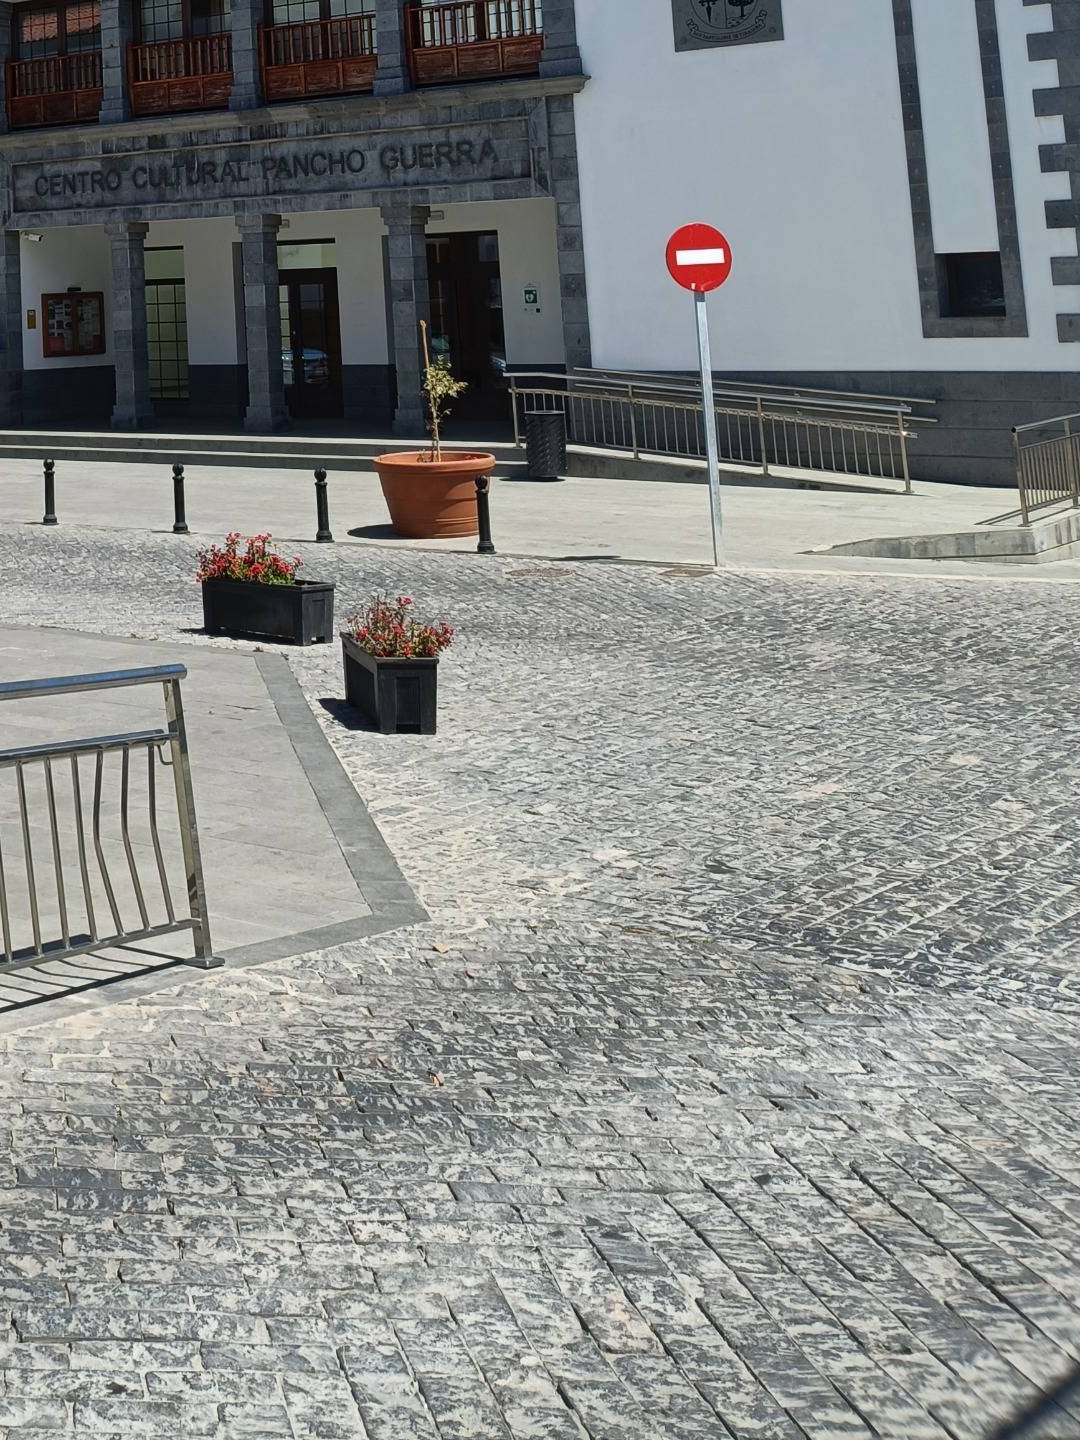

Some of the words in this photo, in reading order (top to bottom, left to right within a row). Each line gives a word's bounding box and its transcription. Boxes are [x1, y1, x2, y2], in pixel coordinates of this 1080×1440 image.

[34, 168, 120, 197] CENTRO
[132, 160, 250, 190] CULTURAL
[261, 148, 366, 180] PANCHO
[379, 138, 499, 171] GUERRA
